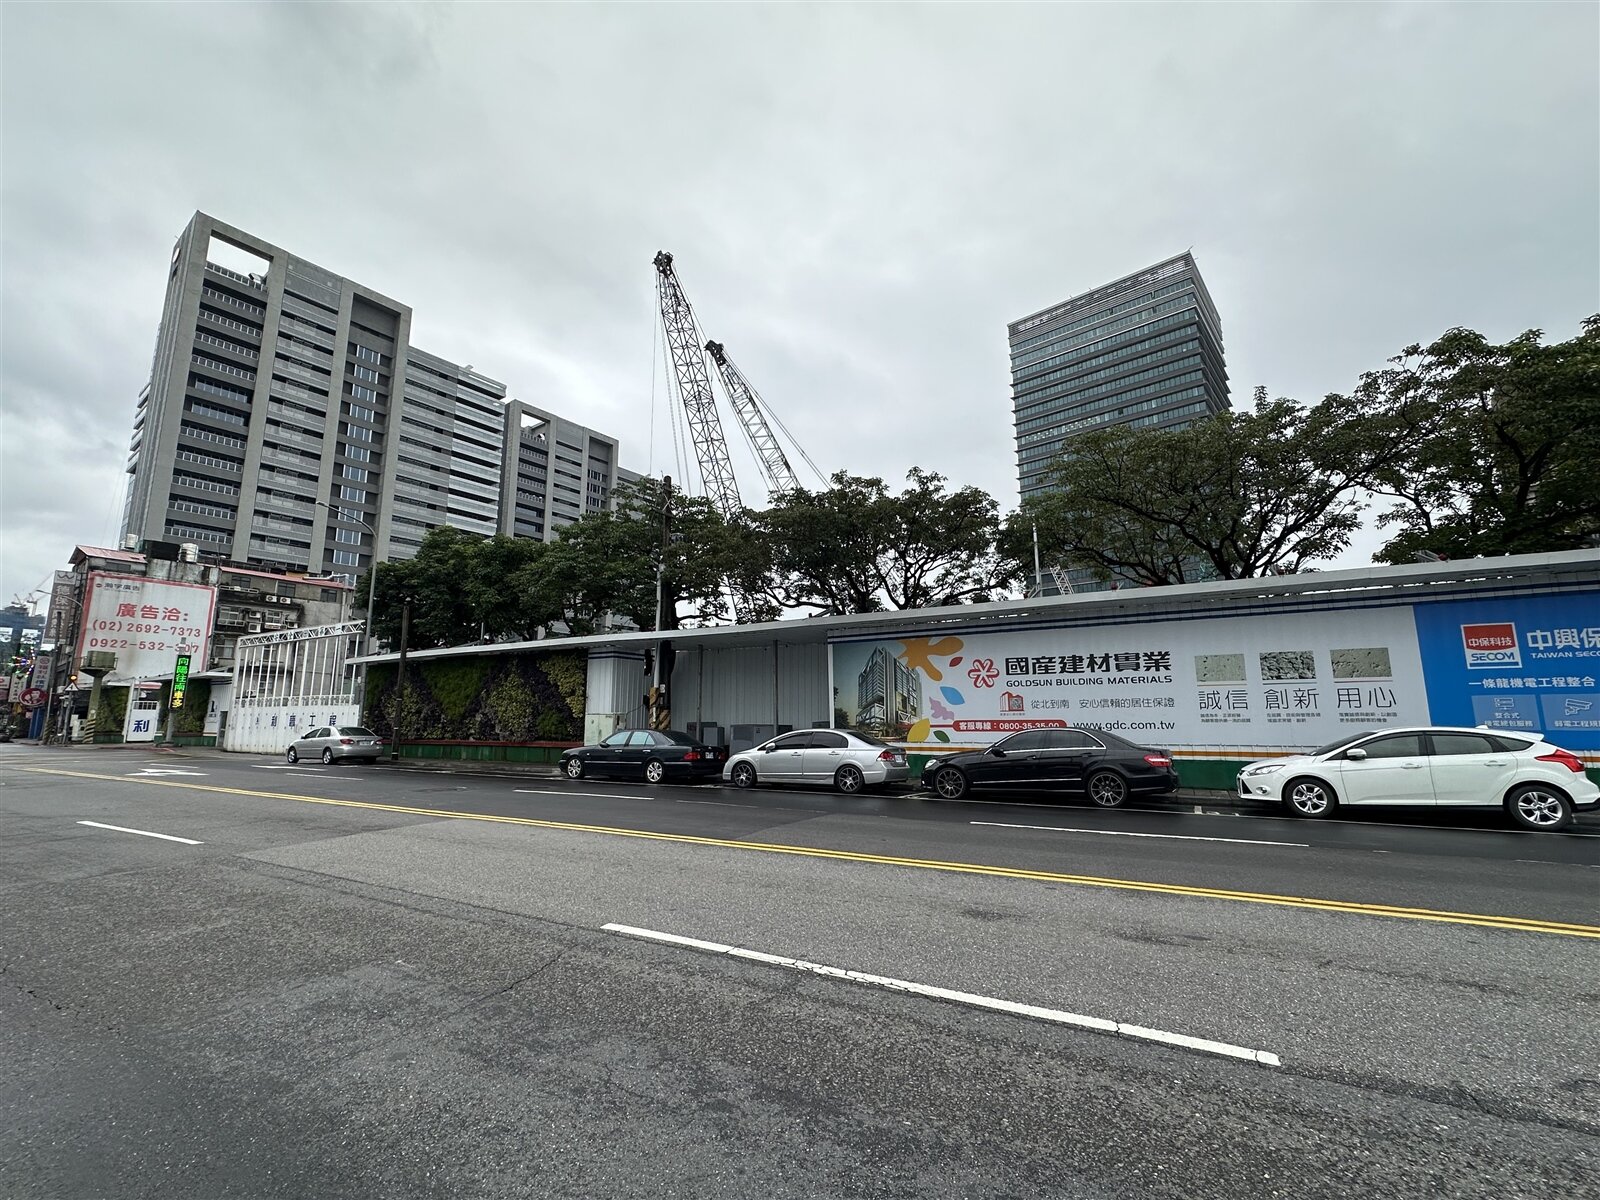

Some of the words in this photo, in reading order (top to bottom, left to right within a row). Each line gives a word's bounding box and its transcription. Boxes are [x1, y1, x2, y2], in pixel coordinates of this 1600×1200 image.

[1468, 636, 1512, 647] 中保科技
[1471, 652, 1515, 661] SECOM
[1004, 651, 1172, 676] 國產建材實業
[1006, 679, 1053, 688] GOLDSUN
[1056, 677, 1104, 687] BUILDING
[1107, 675, 1173, 685] MATERIALS
[1469, 676, 1596, 689] 一條龍機電工程整合
[1031, 698, 1070, 710] 從北到南
[1079, 697, 1176, 709] 安心信賴的居住保證
[1198, 689, 1249, 710] 誠信
[1263, 687, 1320, 710] 創新
[1337, 686, 1397, 709] 用心
[1072, 720, 1176, 731] www.gdc.com.tw
